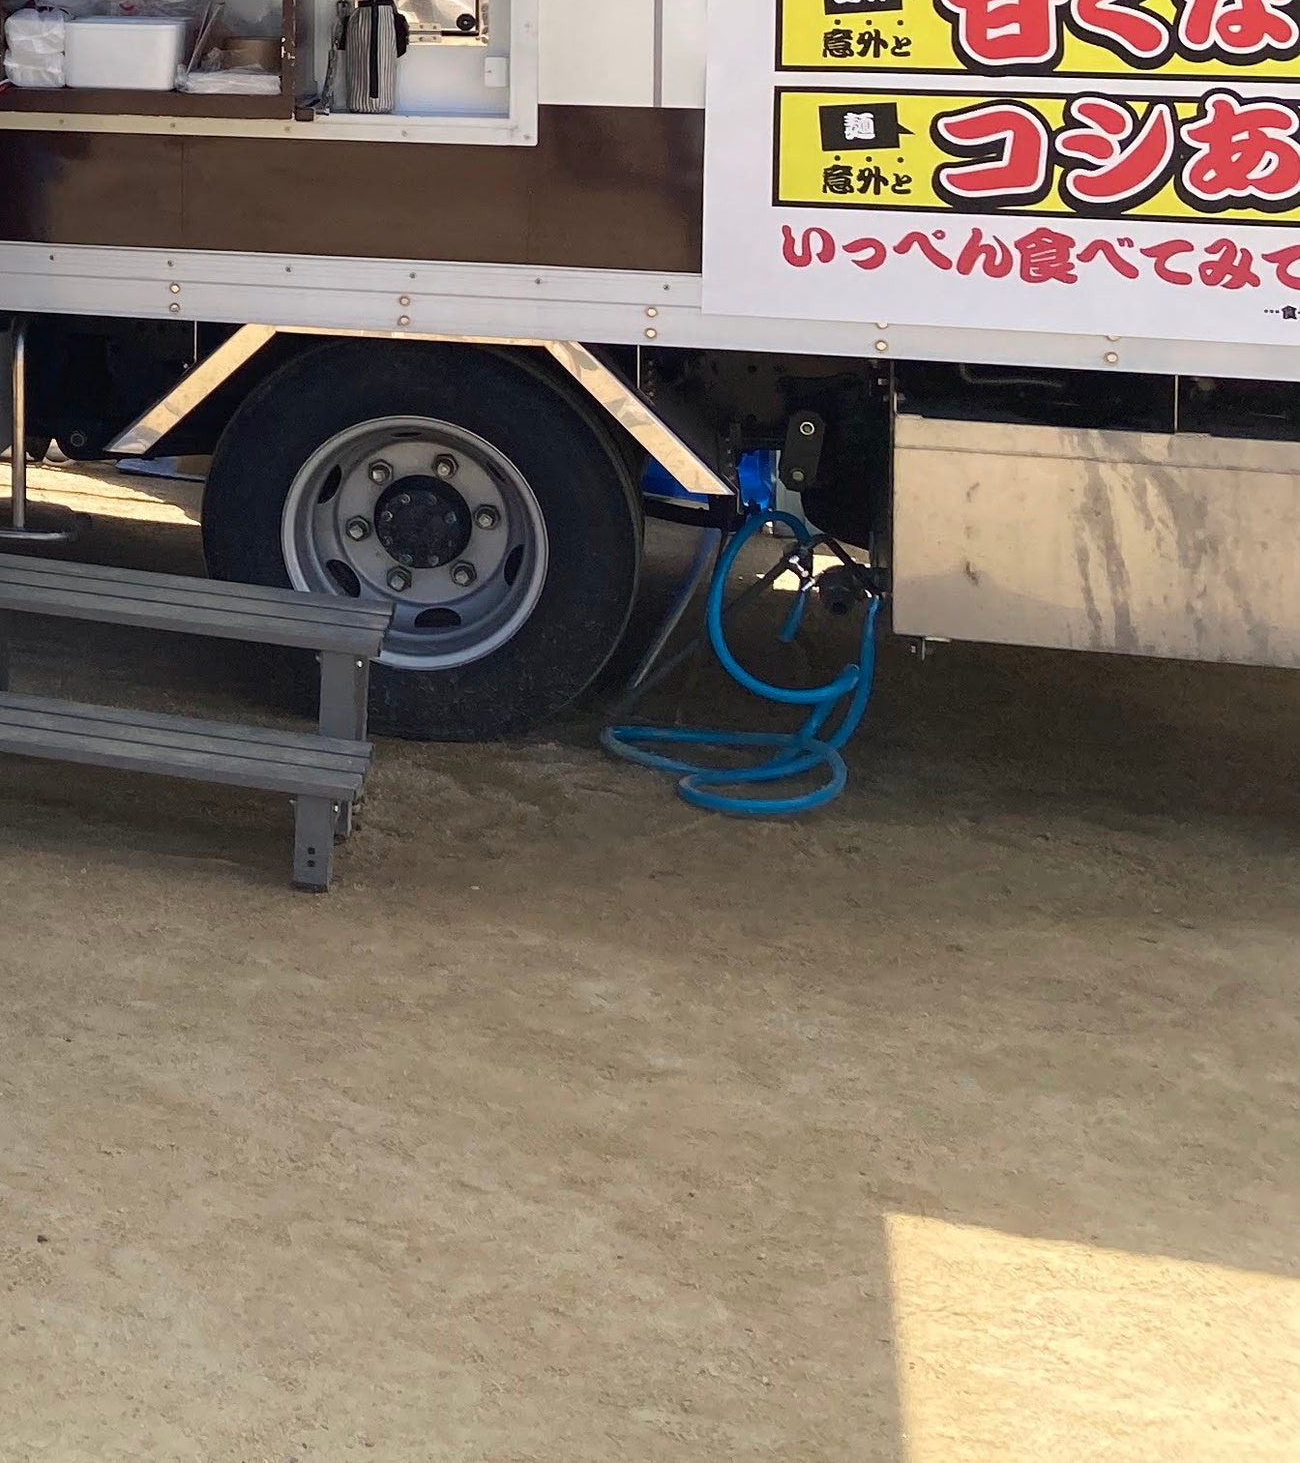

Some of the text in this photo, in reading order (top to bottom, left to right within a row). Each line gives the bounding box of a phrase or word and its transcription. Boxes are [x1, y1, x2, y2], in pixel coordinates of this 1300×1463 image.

[822, 28, 912, 58] 意外と
[822, 93, 1300, 204] 意外と コシあ
[843, 112, 876, 140] 麺
[781, 225, 1300, 290] いっぺん食べてみて
